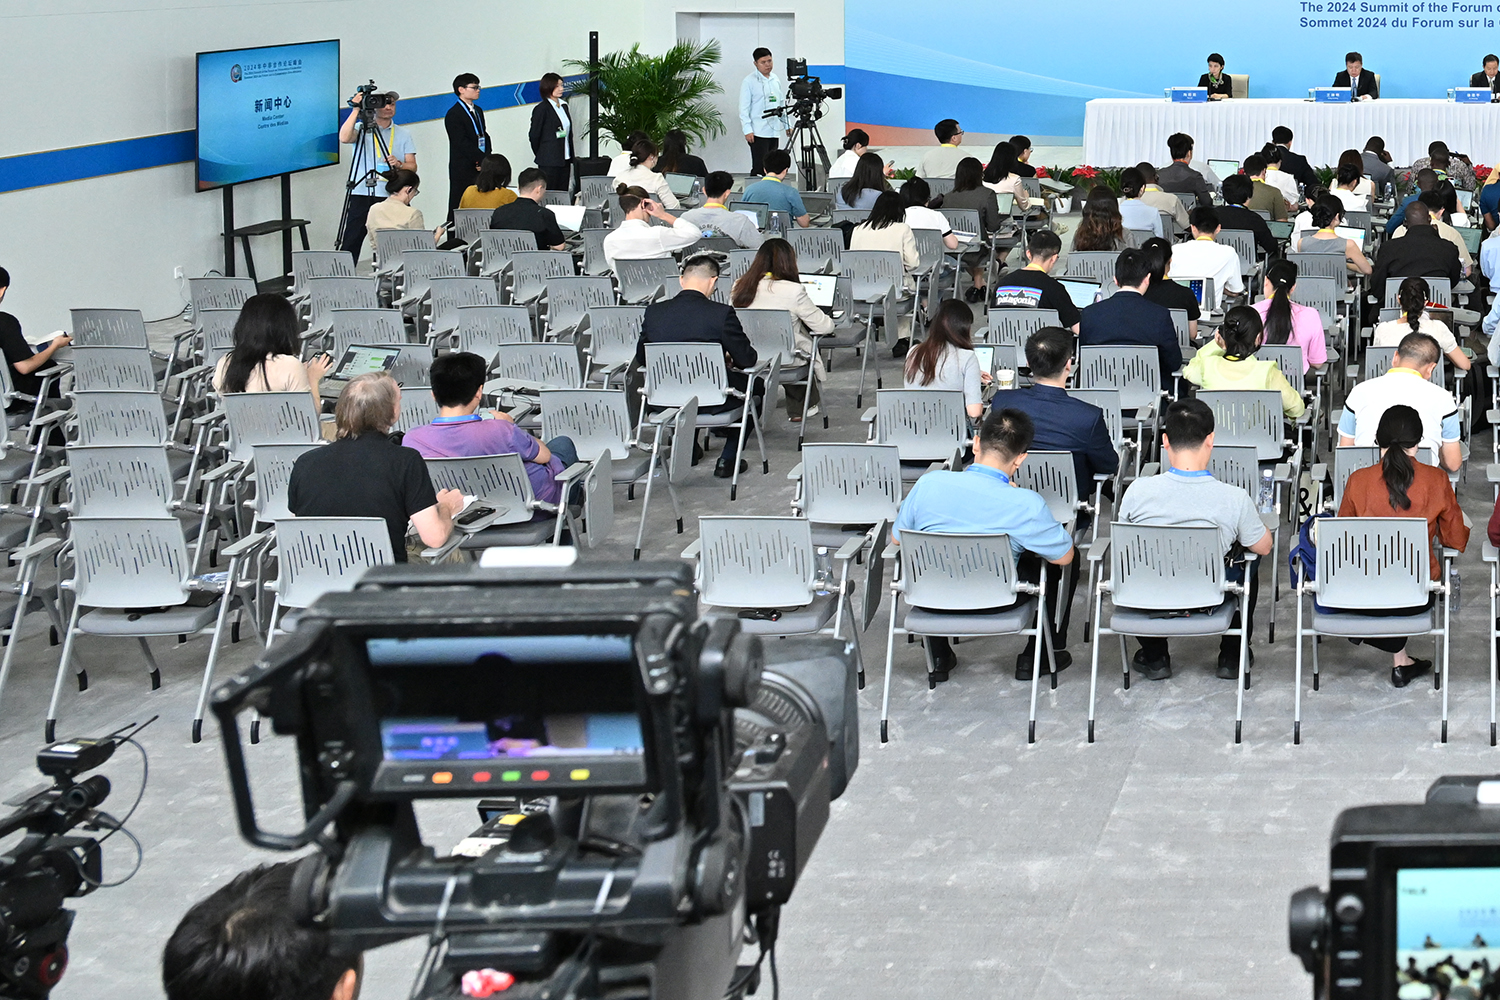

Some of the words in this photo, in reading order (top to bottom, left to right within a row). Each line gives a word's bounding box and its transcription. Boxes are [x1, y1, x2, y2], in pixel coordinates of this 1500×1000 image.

[1300, 2, 1323, 12] The
[1327, 2, 1356, 12] 2024
[1360, 2, 1408, 12] Summit
[1412, 2, 1425, 12] of
[1428, 2, 1448, 12] the
[1452, 2, 1493, 12] Forum
[1300, 17, 1353, 28] Sommet
[1357, 17, 1388, 28] 2024
[1392, 17, 1408, 28] du
[1412, 17, 1454, 28] Forum
[1458, 19, 1480, 28] sur
[1484, 17, 1494, 28] la
[254, 96, 292, 113] 新闻中心
[997, 297, 1036, 306] patagonia
